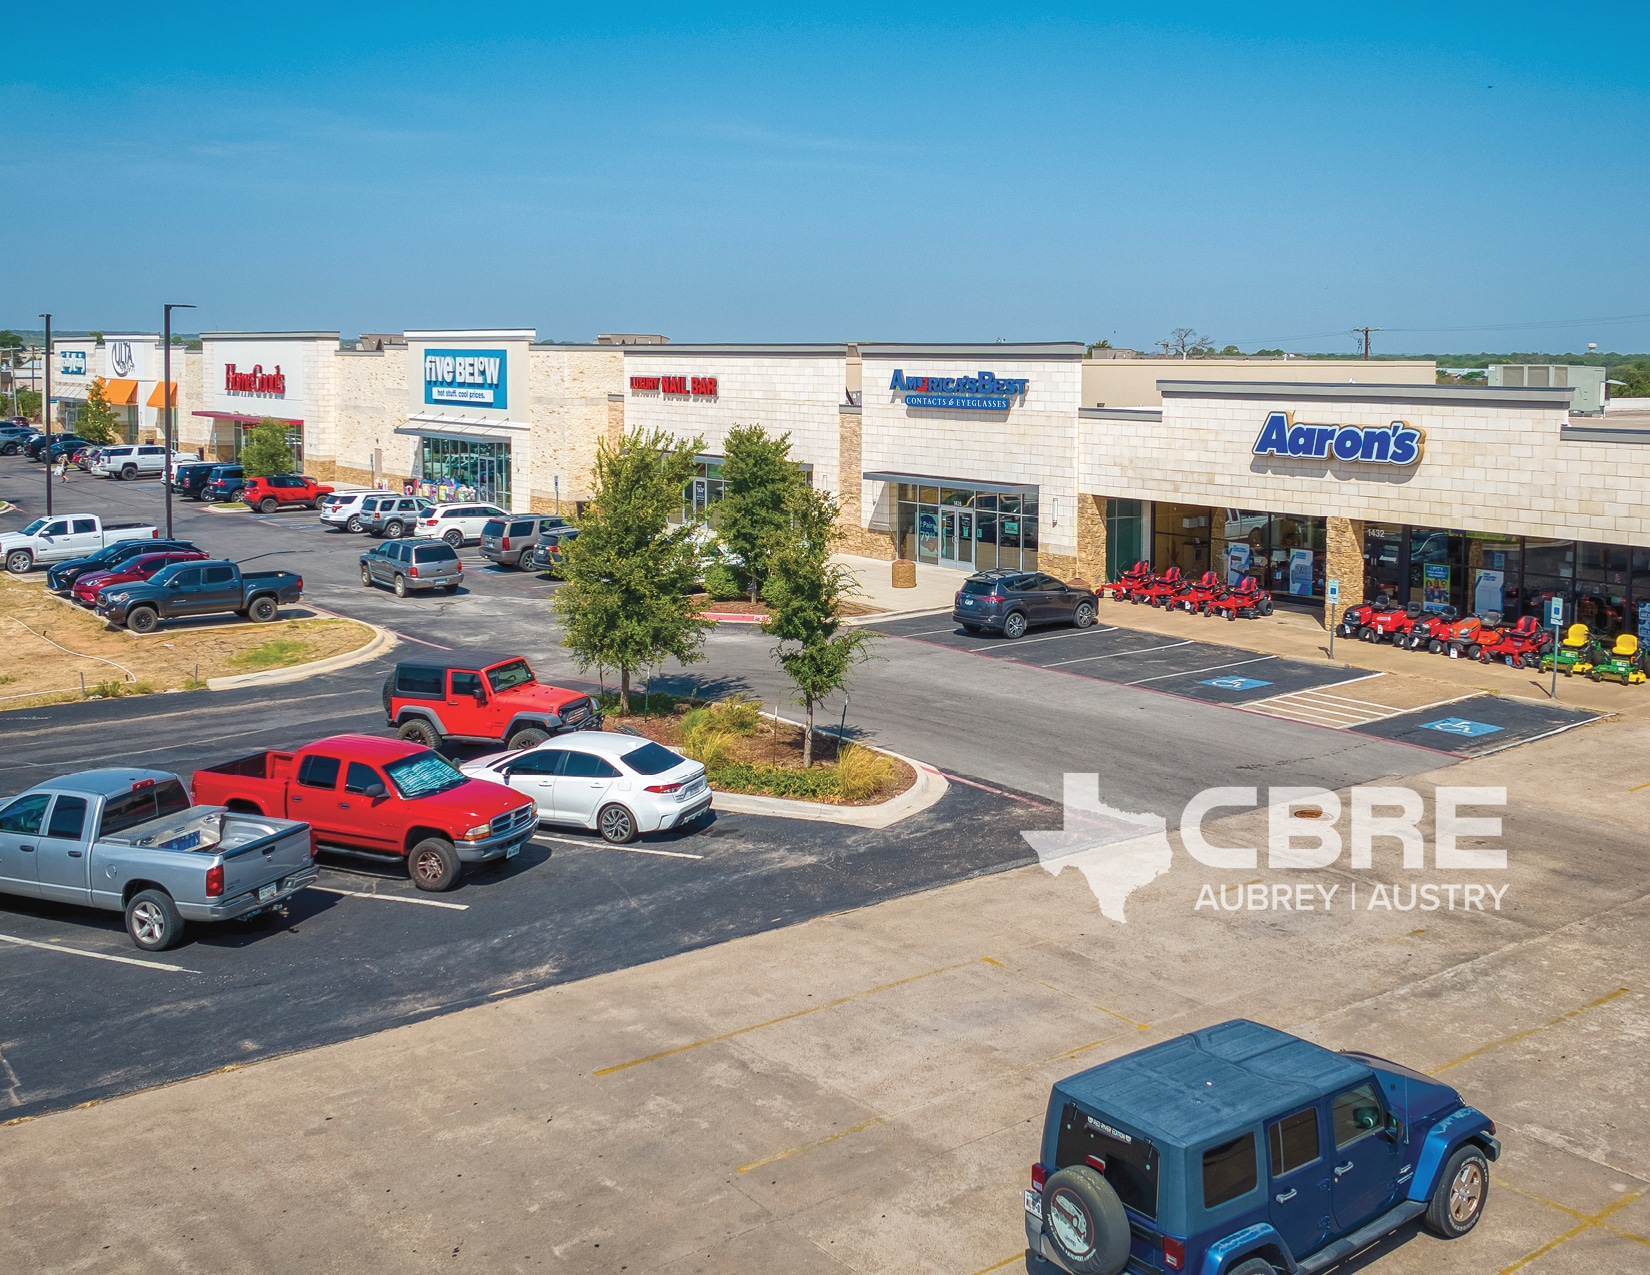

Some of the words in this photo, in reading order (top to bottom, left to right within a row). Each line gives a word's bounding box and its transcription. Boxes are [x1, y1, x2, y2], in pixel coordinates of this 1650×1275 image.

[225, 363, 286, 394] HomeGoods
[425, 355, 455, 383] five
[437, 389, 445, 397] hot
[458, 390, 469, 398] cool
[630, 376, 660, 391] LUXURY
[661, 376, 690, 395] NAIL
[691, 376, 717, 396] BAR
[906, 397, 947, 406] CONTACTS
[949, 398, 954, 406] &
[956, 398, 1007, 408] EYEGLASSES
[1253, 413, 1423, 464] Aaron's
[1367, 528, 1385, 538] 1432
